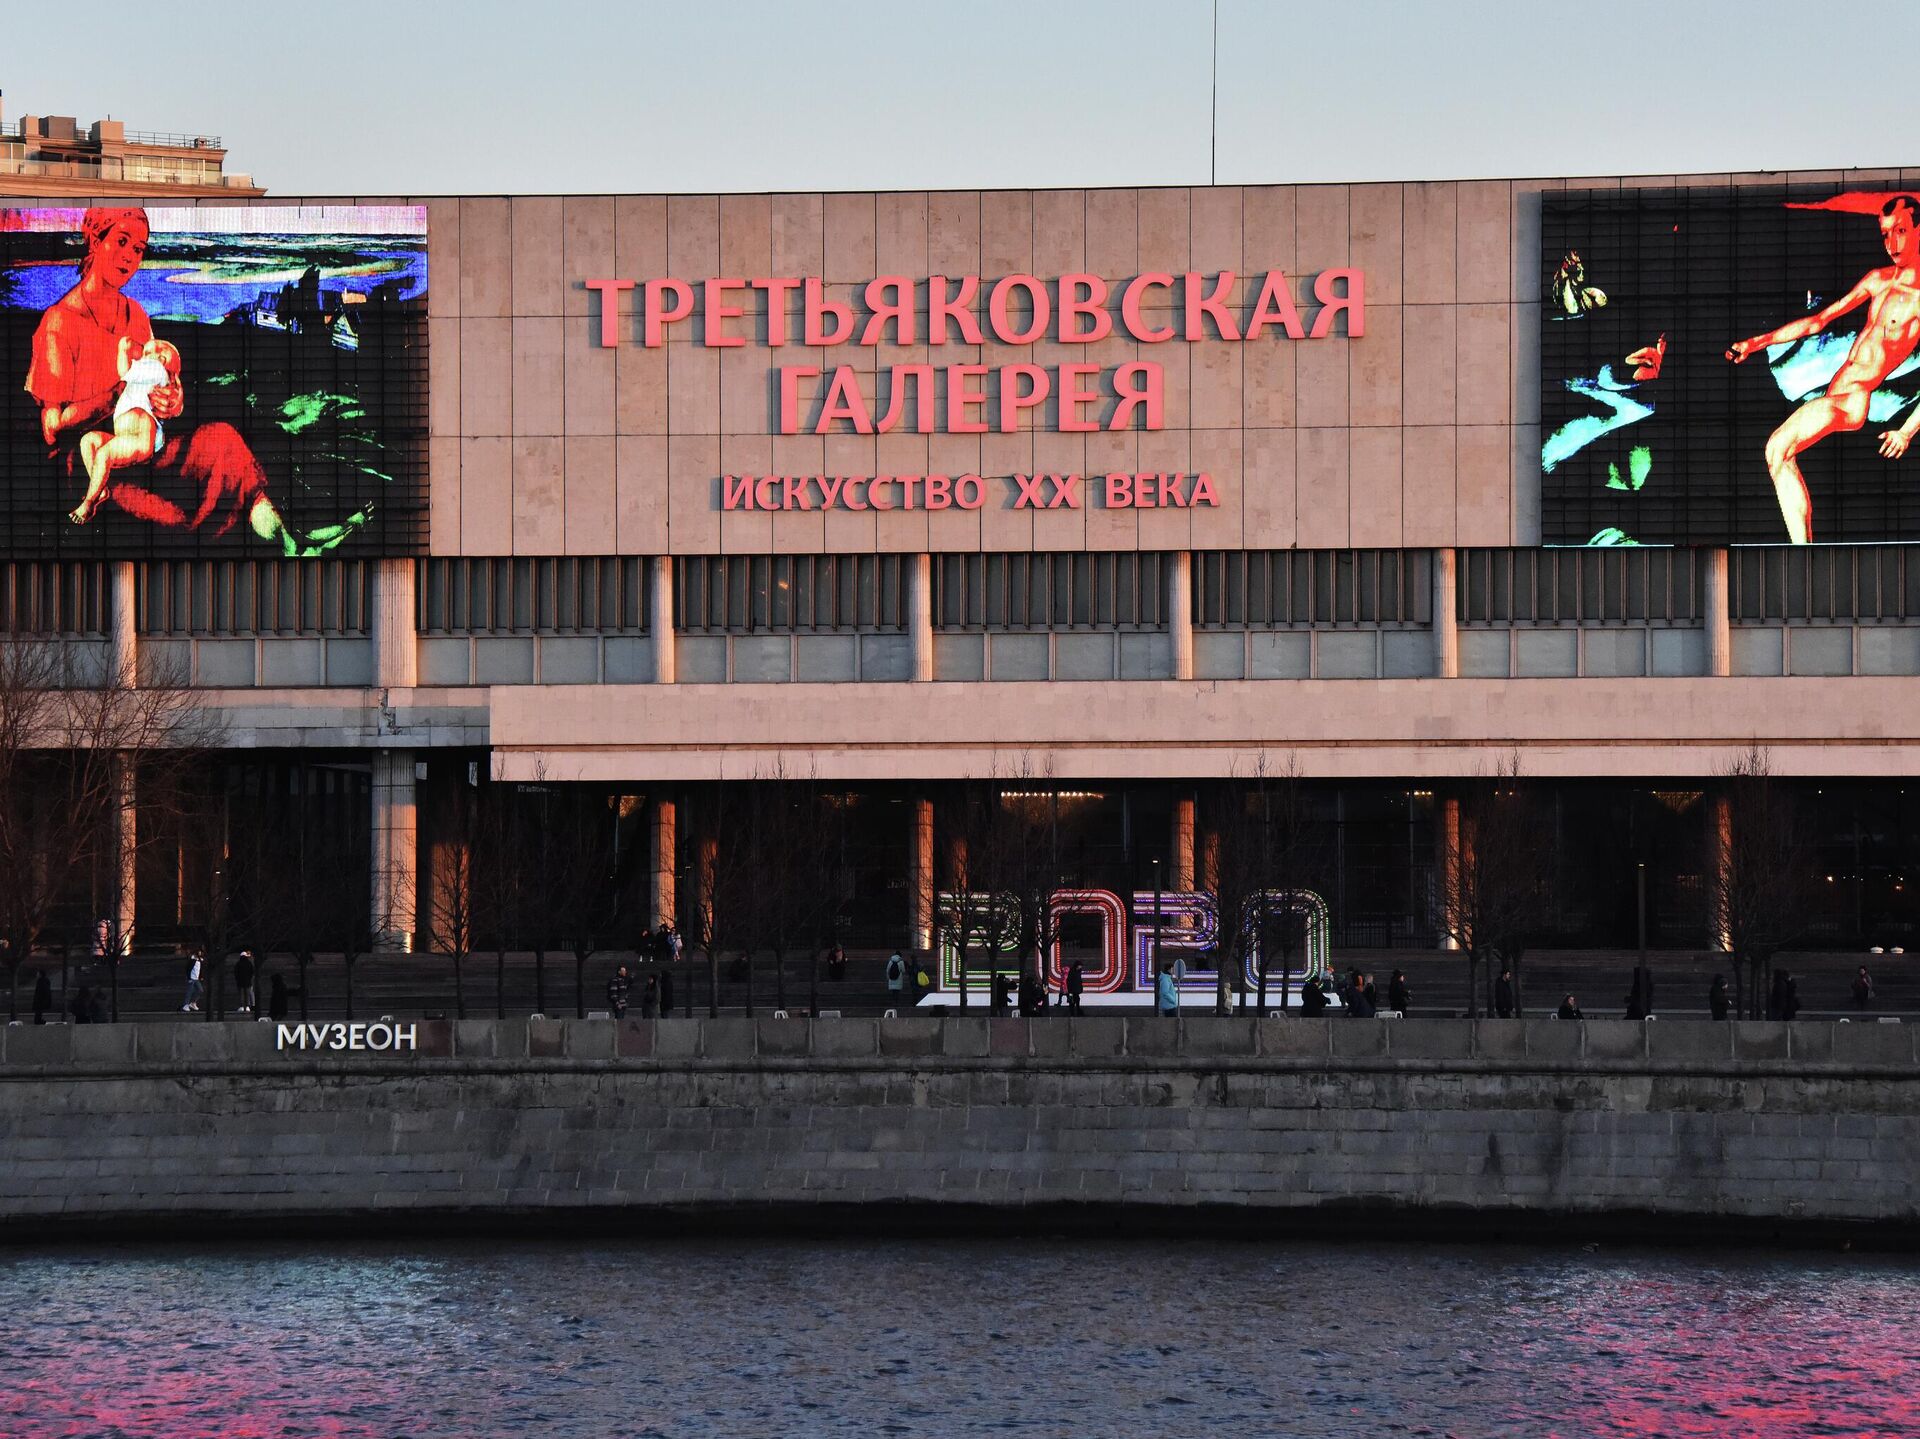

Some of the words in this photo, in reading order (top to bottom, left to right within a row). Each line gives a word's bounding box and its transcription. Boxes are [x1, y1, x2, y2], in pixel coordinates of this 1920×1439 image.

[586, 267, 1365, 348] ТРЕТЬЯКОВСКАЯ
[780, 361, 1164, 434] ГАЛЕРЕЯ
[722, 473, 987, 511] ИСКУССТВО
[1105, 472, 1221, 508] ВЕКА
[277, 1023, 417, 1050] МУЗЕОН
